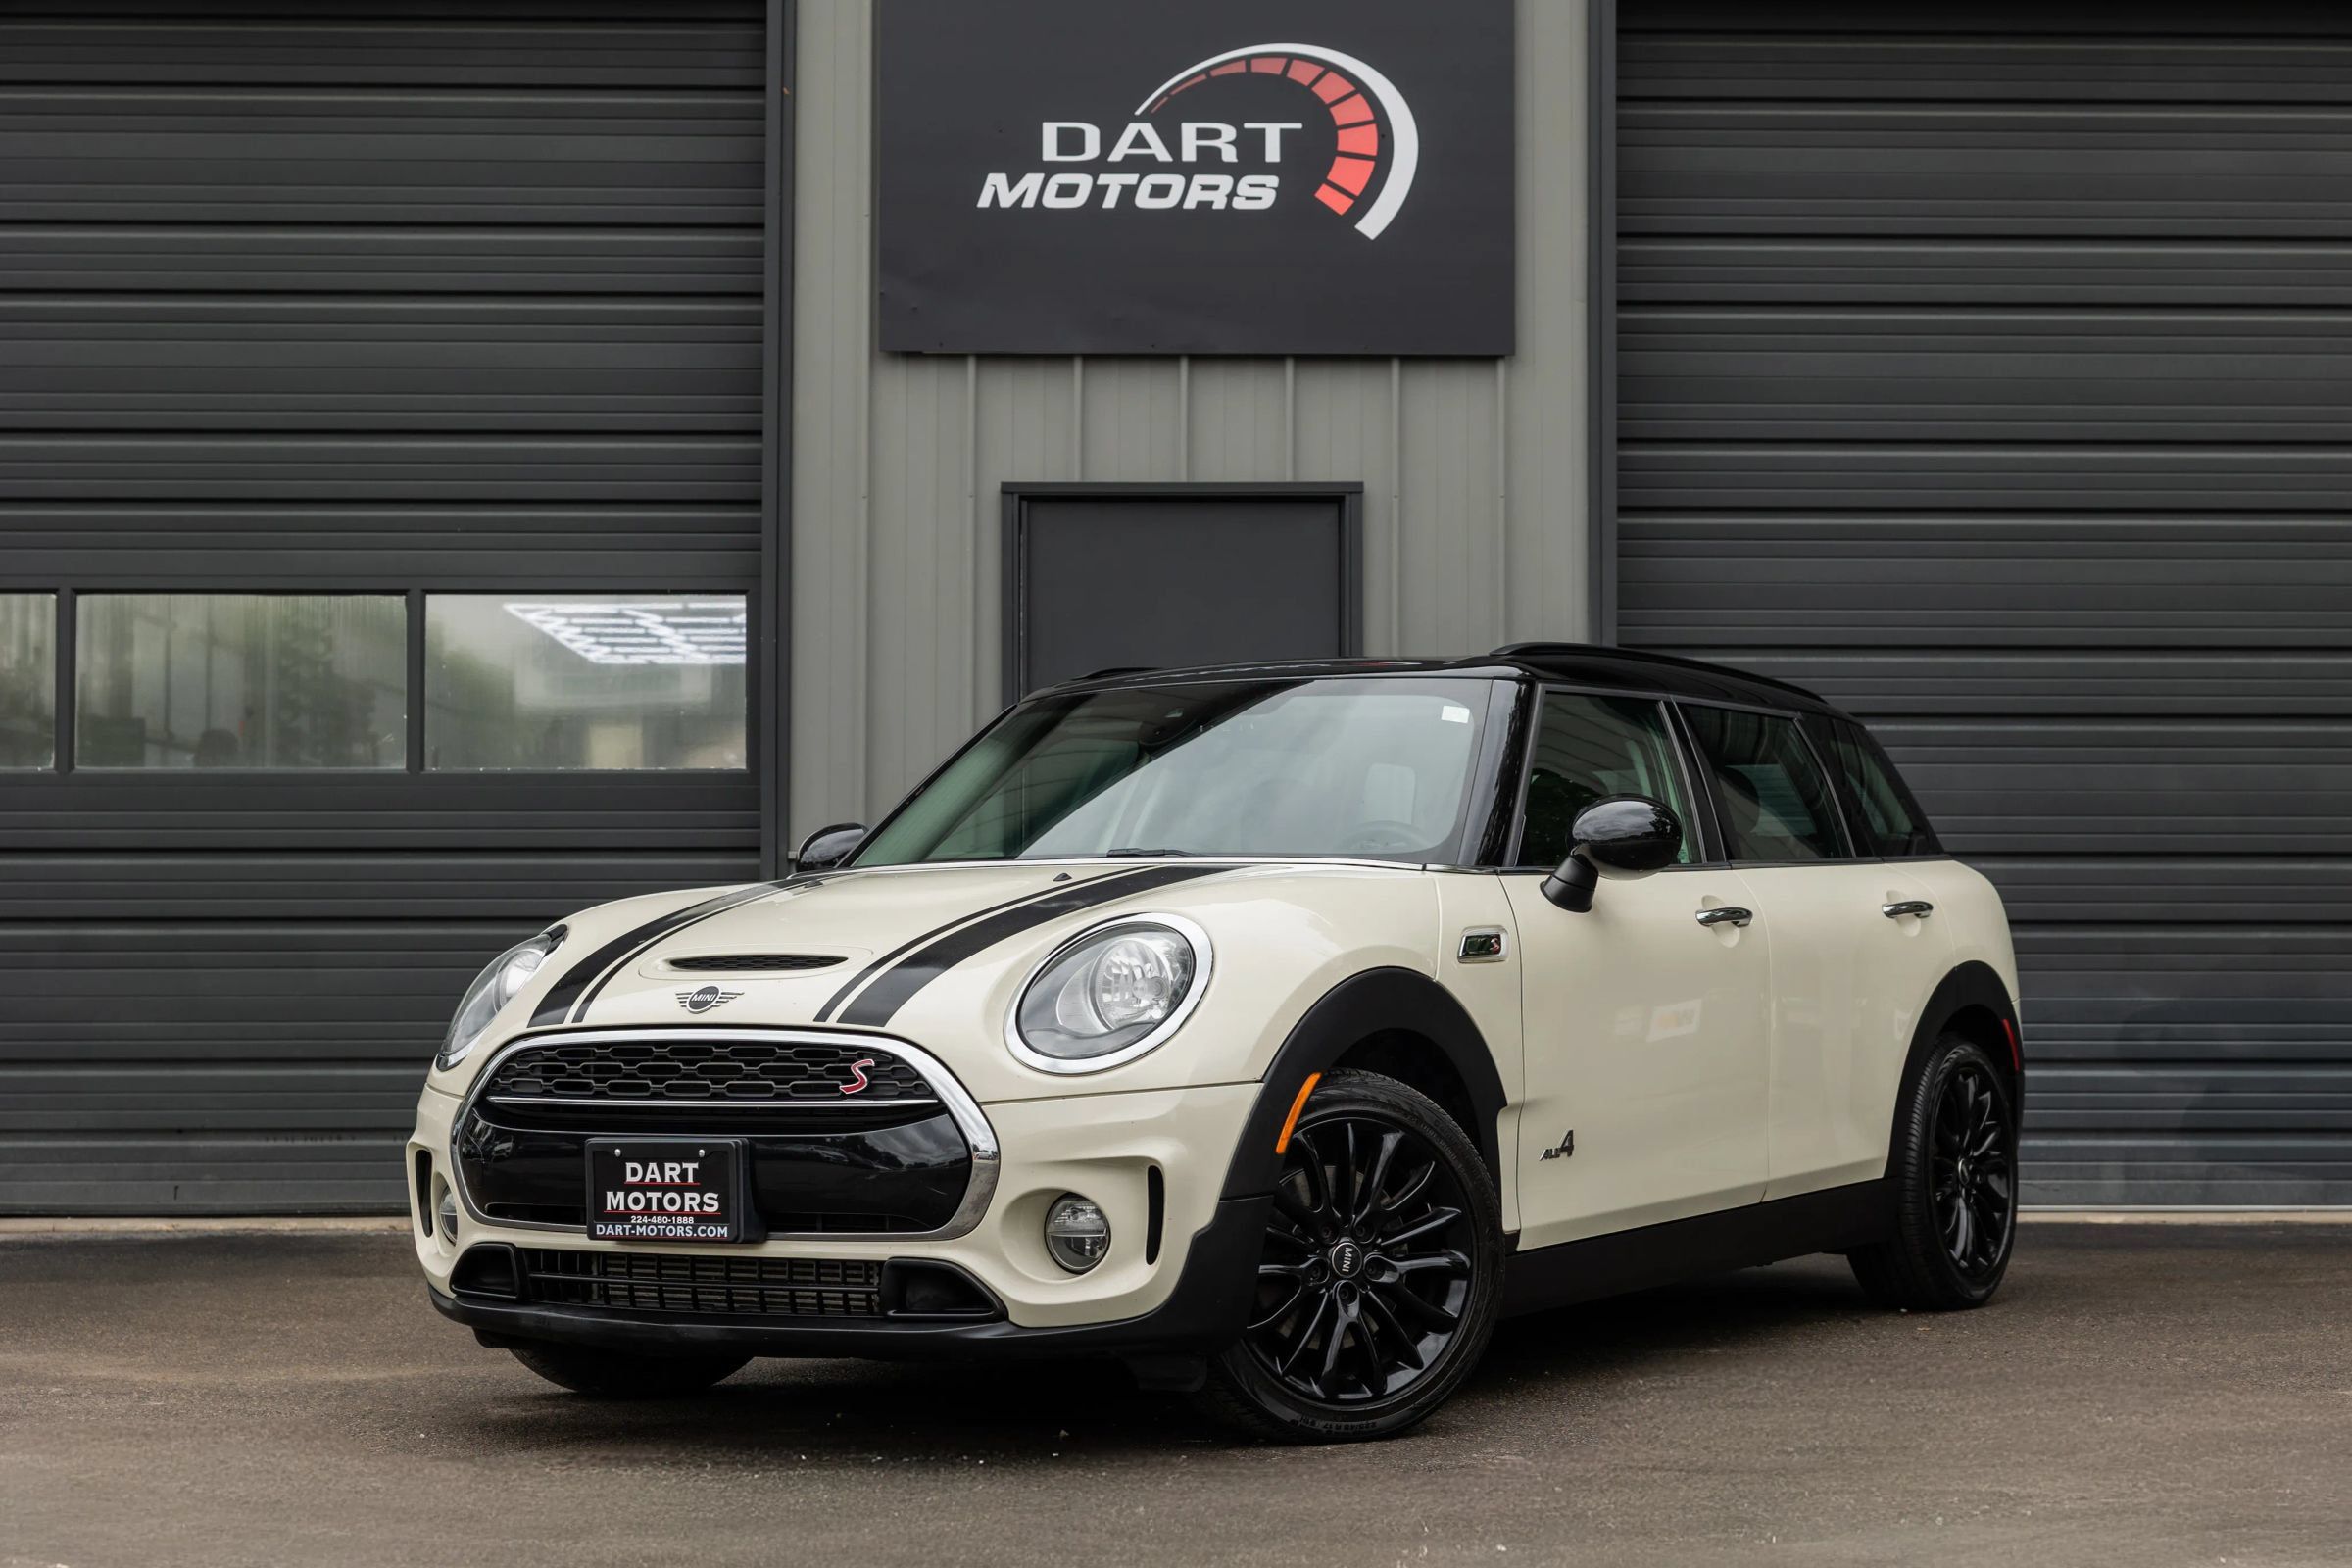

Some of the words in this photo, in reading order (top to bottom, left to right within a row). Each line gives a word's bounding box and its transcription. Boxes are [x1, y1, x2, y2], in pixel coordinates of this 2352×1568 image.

[1042, 121, 1303, 163] DART
[976, 172, 1280, 210] MOTORS
[691, 993, 717, 1002] MINI
[839, 1058, 875, 1095] S
[624, 1161, 699, 1184] DART
[605, 1191, 720, 1213] MOTORS
[596, 1224, 728, 1238] DART-MOTORS.COM
[630, 1215, 695, 1225] 224-480-1888
[1342, 1247, 1353, 1273] MINI
